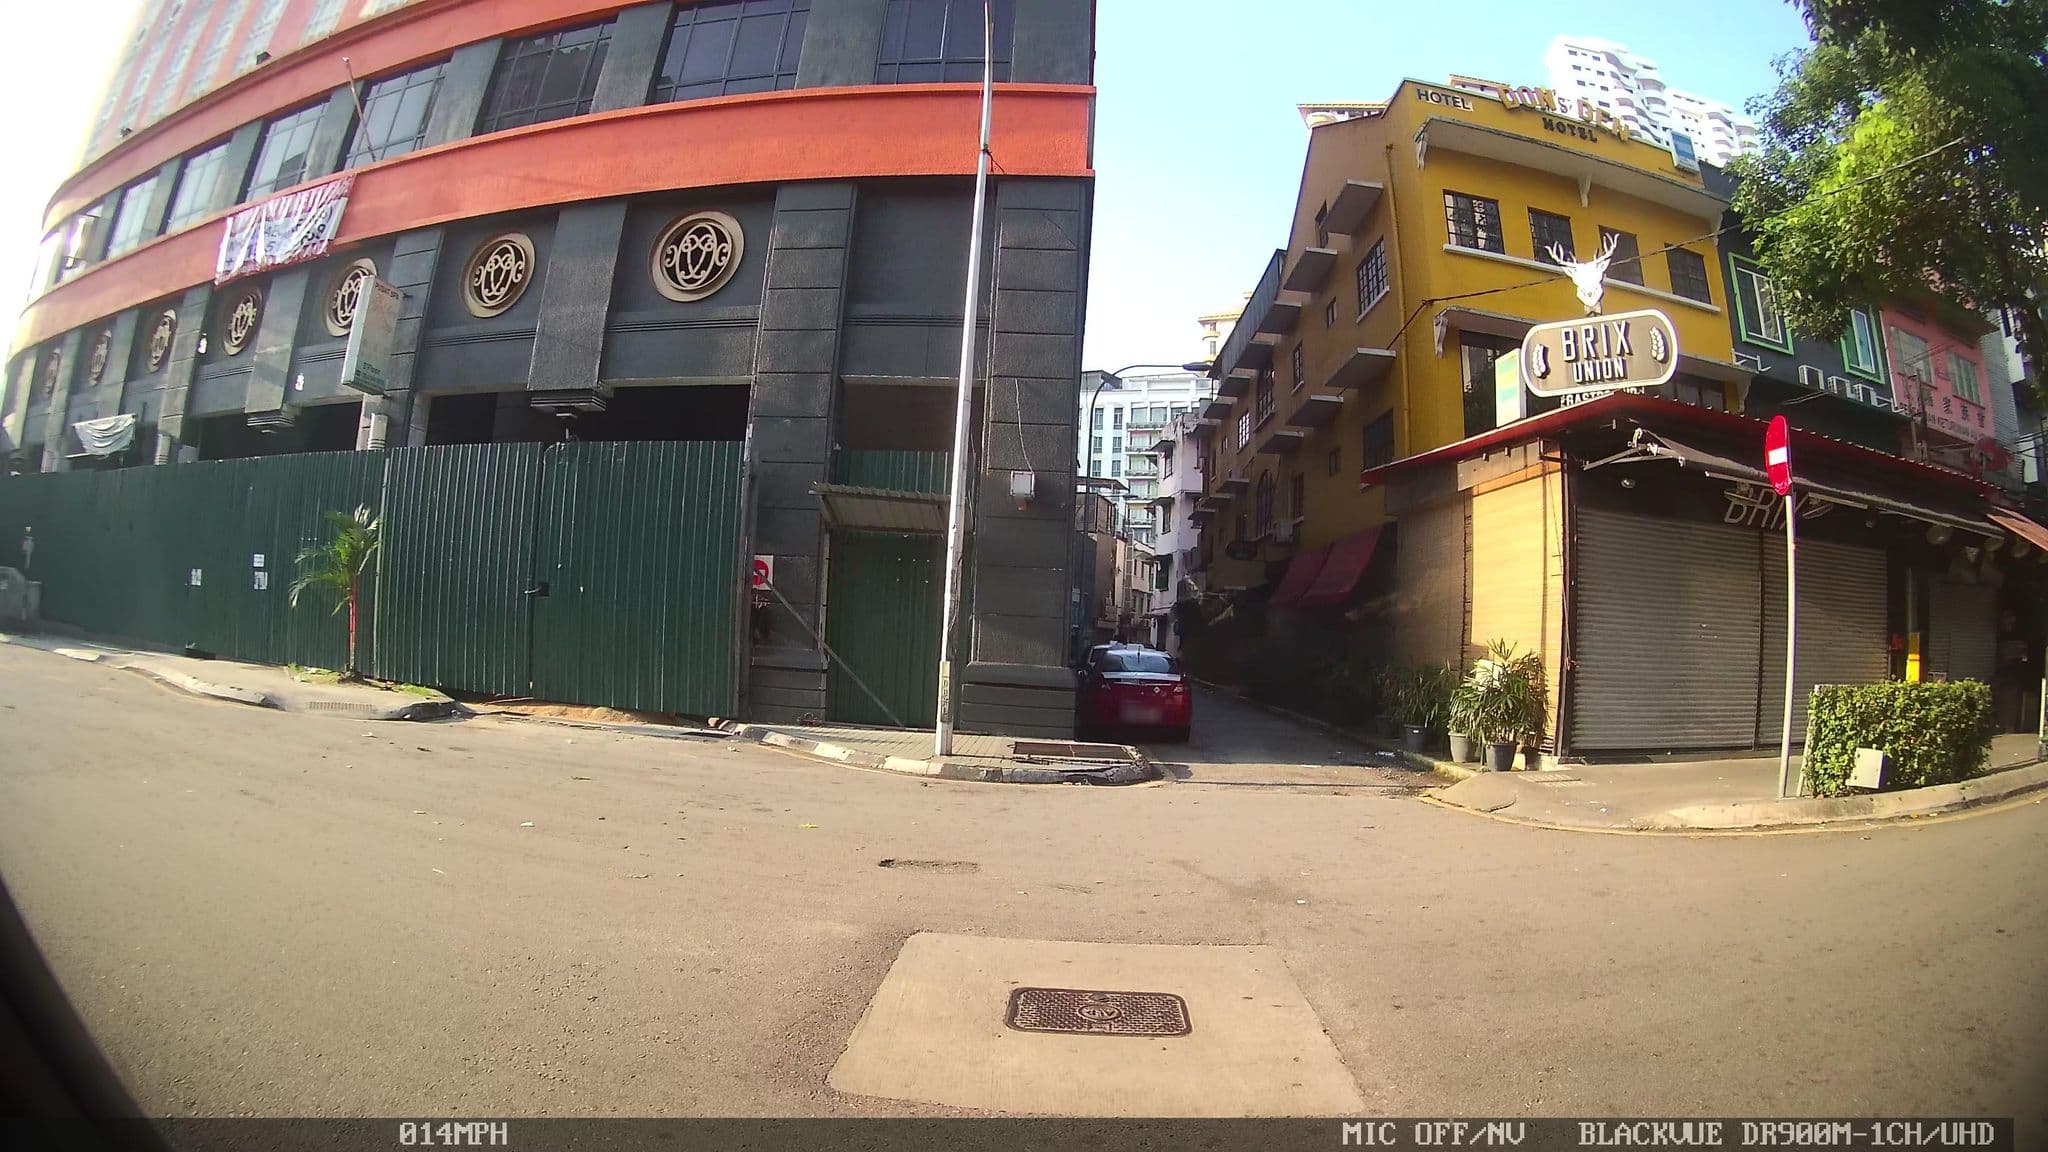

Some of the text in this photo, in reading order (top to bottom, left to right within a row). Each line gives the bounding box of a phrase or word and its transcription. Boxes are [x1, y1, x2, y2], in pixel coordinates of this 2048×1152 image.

[1417, 89, 1473, 111] HOTEL
[1541, 117, 1598, 142] HOTEL
[1561, 320, 1631, 362] BRIX
[1573, 357, 1627, 384] UNION
